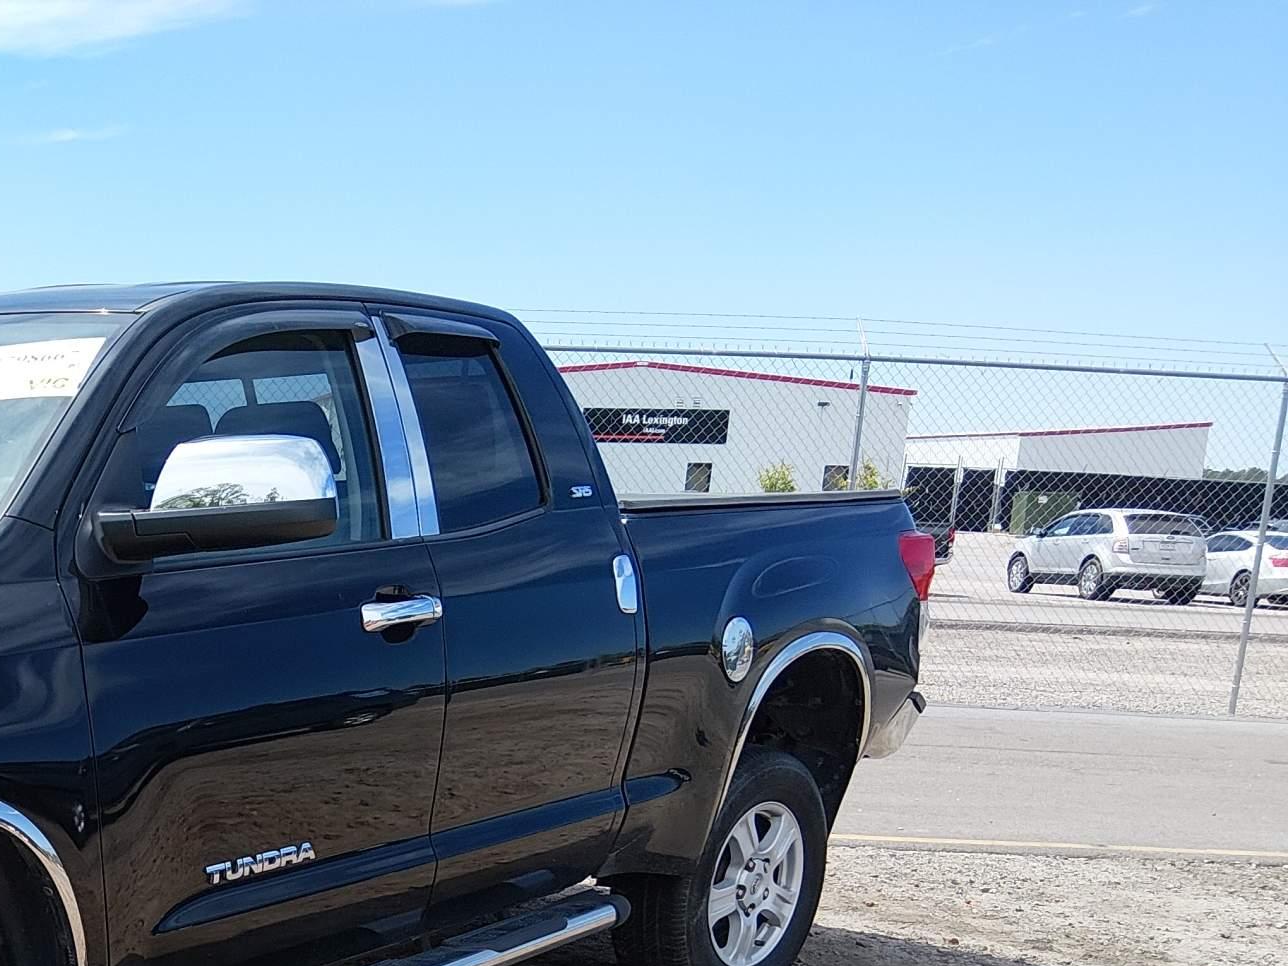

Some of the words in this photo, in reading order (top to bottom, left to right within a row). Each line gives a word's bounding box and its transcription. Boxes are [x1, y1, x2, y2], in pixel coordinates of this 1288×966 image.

[622, 414, 640, 424] IAA
[642, 414, 689, 427] Lexington
[206, 842, 316, 885] TUNDRA
